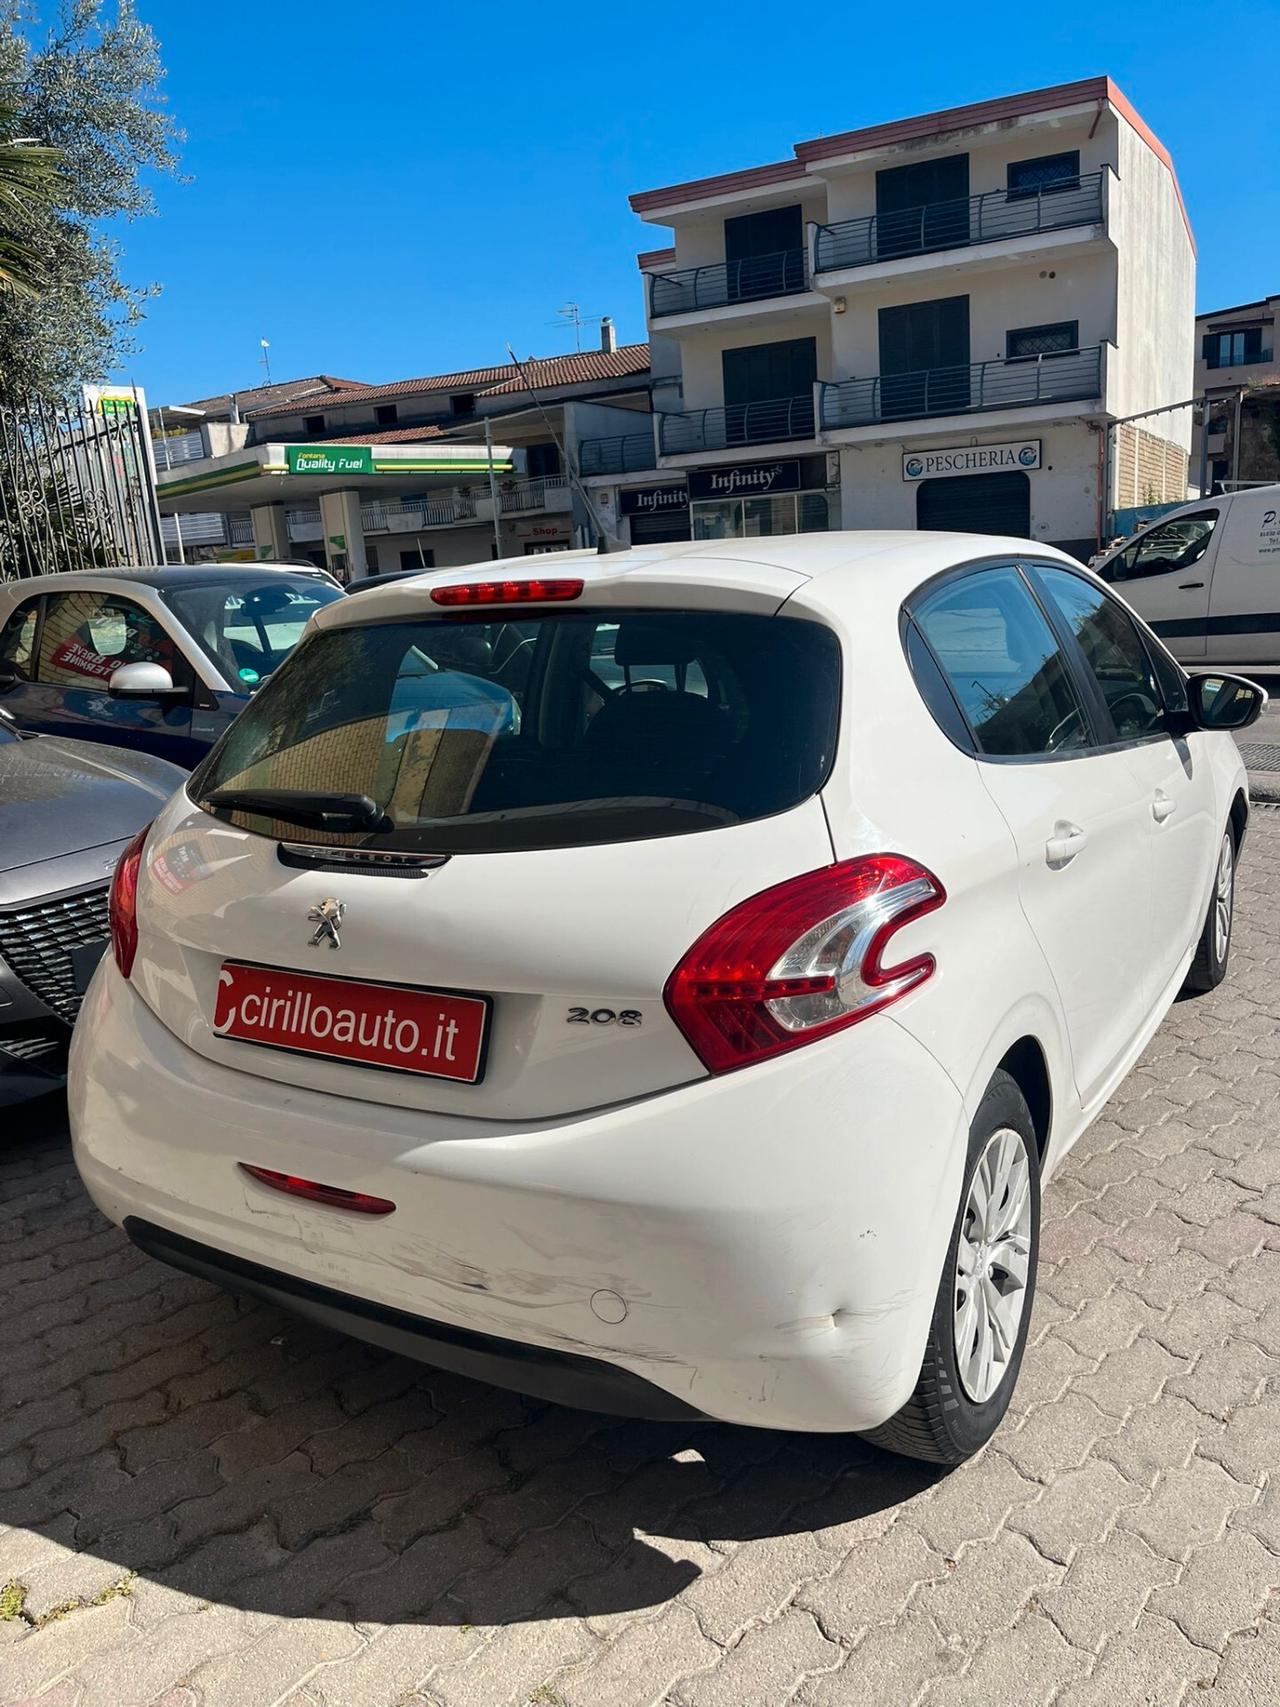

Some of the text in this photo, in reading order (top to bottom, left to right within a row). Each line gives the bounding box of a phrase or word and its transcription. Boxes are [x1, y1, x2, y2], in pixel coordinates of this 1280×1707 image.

[296, 458, 363, 472] Quality Fuel
[926, 449, 1016, 472] PESCHERIA
[710, 469, 775, 494] Infinity
[637, 488, 688, 512] Infinity
[532, 527, 558, 536] Shop
[566, 1007, 642, 1028] 208
